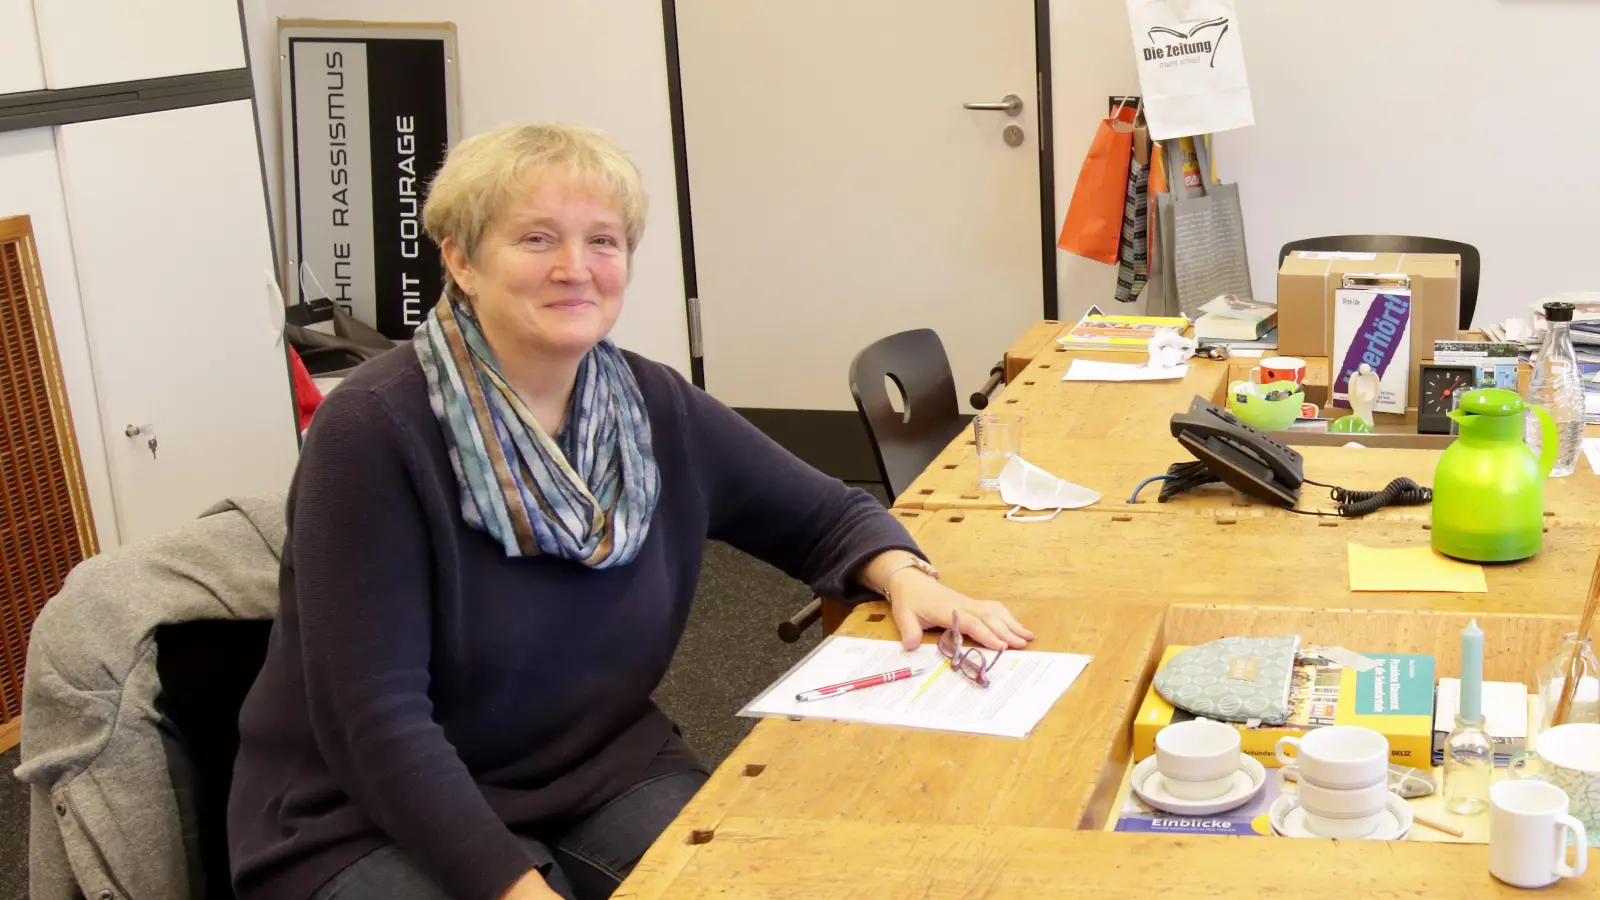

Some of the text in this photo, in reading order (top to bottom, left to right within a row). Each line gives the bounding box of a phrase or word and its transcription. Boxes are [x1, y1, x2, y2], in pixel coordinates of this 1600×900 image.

[1143, 40, 1212, 61] Die Zeitung
[326, 51, 350, 227] RASSISMUS
[396, 115, 420, 326] MIT COURAGE
[1343, 294, 1409, 383] erhört!
[1151, 818, 1232, 828] Einblicke
